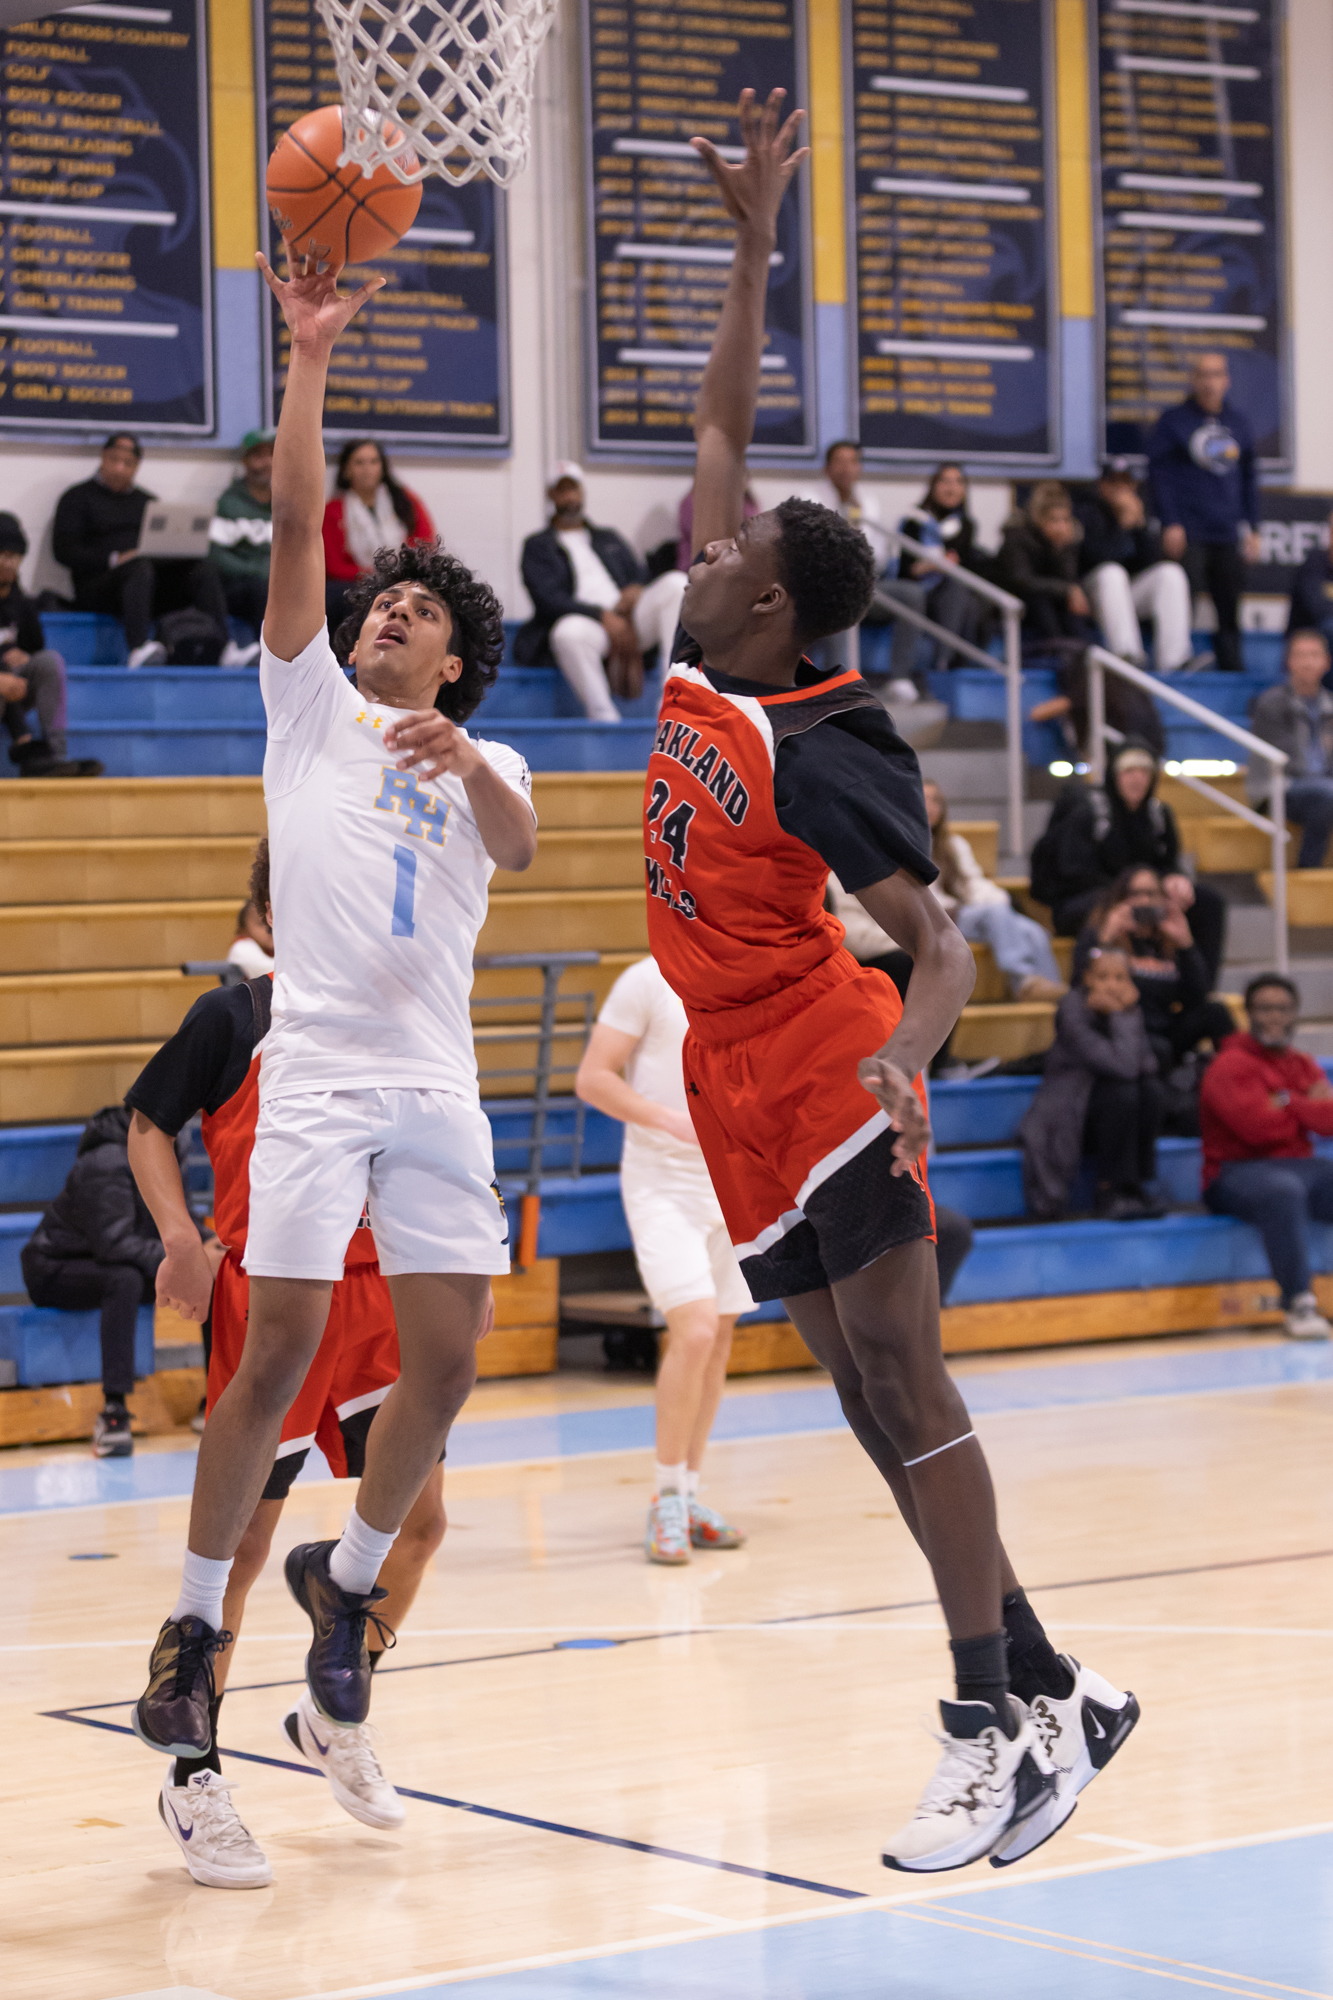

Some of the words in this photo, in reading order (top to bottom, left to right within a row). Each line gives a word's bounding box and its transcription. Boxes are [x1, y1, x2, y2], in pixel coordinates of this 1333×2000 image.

[6, 40, 91, 63] FOOTBALL
[8, 132, 133, 157] CHEERLEADING
[10, 224, 95, 244] FOOTBALL
[11, 270, 136, 291] CHEERLEADING
[12, 337, 96, 357] FOOTBALL
[653, 719, 749, 826] AKLAND
[374, 766, 452, 847] RH
[646, 778, 697, 873] 24
[391, 843, 418, 939] 1
